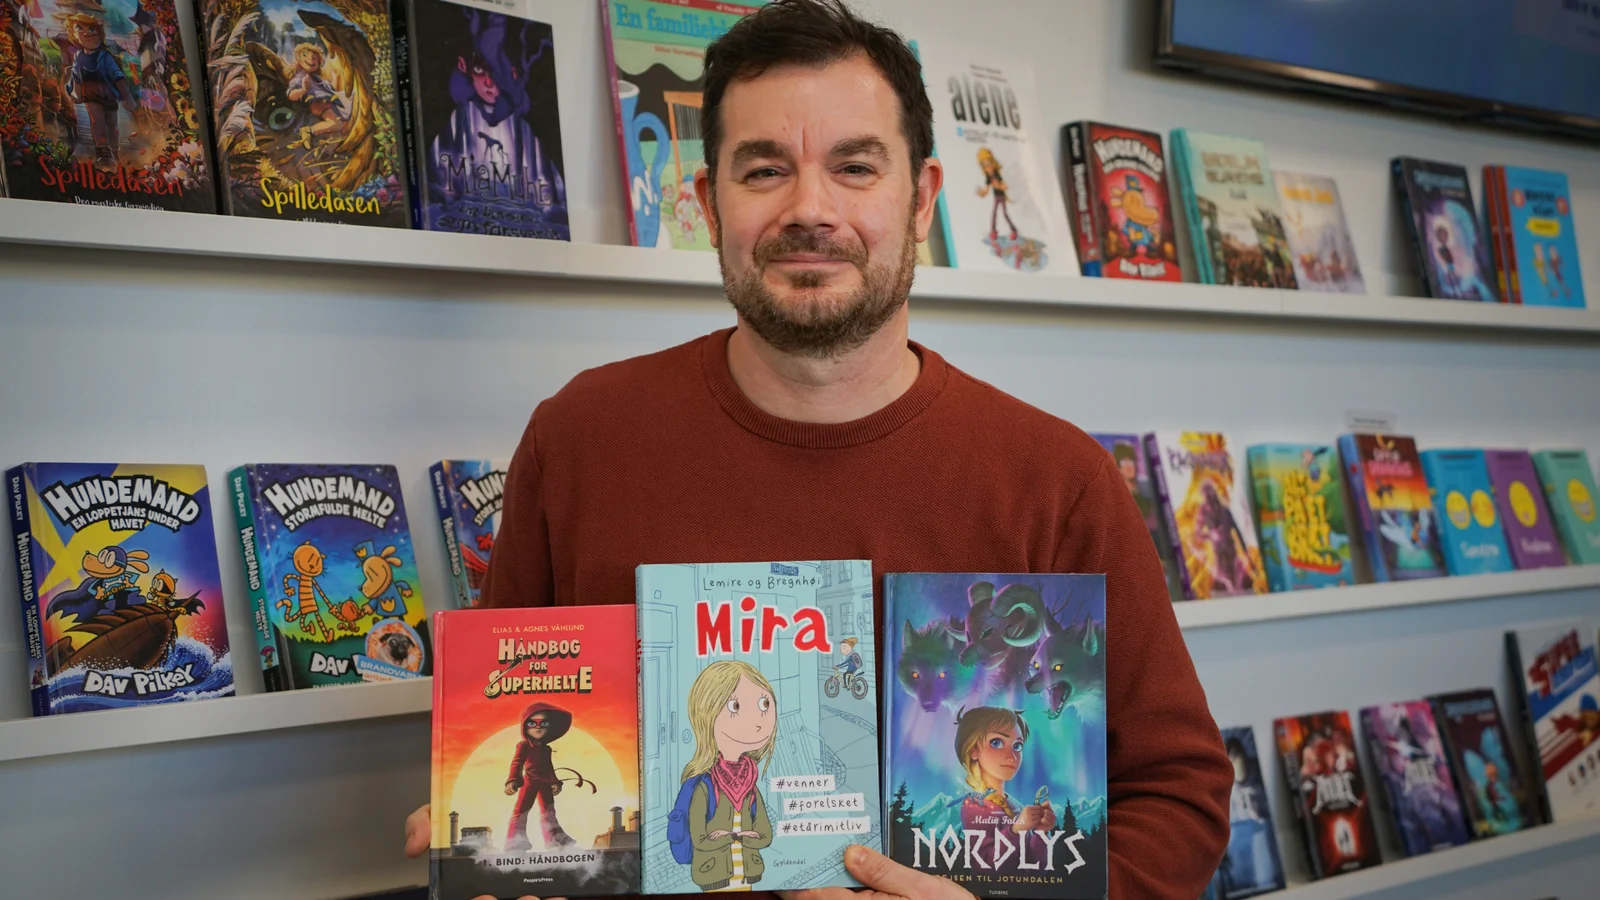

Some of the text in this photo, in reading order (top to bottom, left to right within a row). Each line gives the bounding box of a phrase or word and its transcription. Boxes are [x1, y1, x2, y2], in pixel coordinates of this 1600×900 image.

[614, 4, 643, 29] En
[948, 76, 1021, 130] alene
[260, 177, 381, 215] Spilledåsen
[45, 478, 199, 522] HUNDEMAND
[264, 477, 395, 516] HUNDEMAND
[72, 506, 180, 530] EN LOPPETJANS UNDER
[111, 519, 145, 530] HAVET
[285, 503, 386, 530] STORMFULDE HELTE
[16, 532, 34, 602] HUNDEMAND
[241, 526, 259, 591] HUNDEMAND
[703, 576, 821, 591] Lemire og Bregnhøi
[523, 625, 549, 633] AGNES
[551, 623, 585, 631] VÅHLUND
[695, 596, 833, 658] Mira
[498, 638, 581, 662] HÅNDBOG
[310, 653, 349, 674] DAV
[529, 661, 548, 673] FOR
[84, 673, 128, 695] DAV
[484, 665, 593, 697] SUPERHELTE
[776, 779, 829, 789] #venner
[788, 798, 859, 811] #forelsket
[782, 820, 863, 834] #etårimitliv
[972, 815, 999, 825] Malin
[483, 853, 595, 867] 1. BIND: HÅNDBOGEN
[910, 824, 1087, 875] NORDLYS
[773, 859, 807, 868] Gyldendal
[997, 876, 1063, 884] JOTUNDALEN
